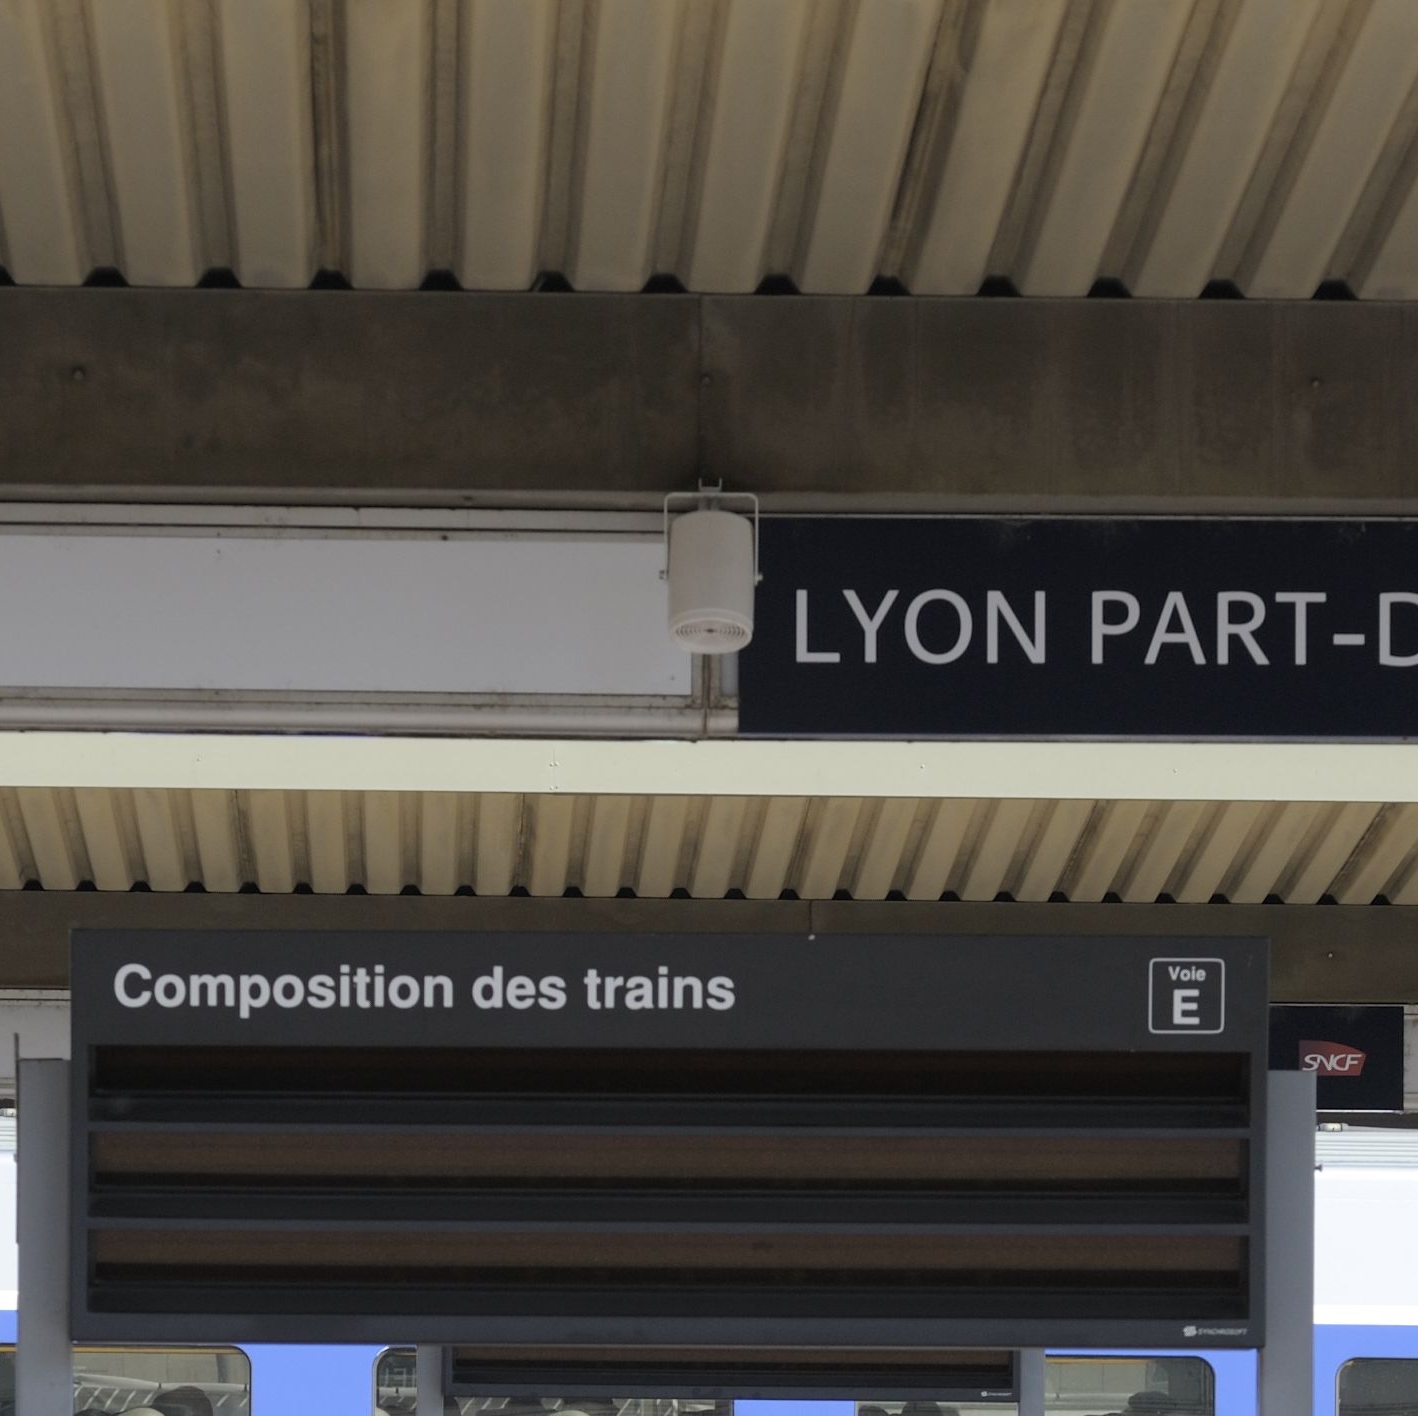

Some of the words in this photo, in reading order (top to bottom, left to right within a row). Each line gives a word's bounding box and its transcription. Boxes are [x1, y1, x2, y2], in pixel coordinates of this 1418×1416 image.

[795, 588, 1047, 665] LYON
[112, 963, 455, 1019] Composition
[471, 965, 568, 1010] des
[583, 965, 737, 1010] trains
[1167, 965, 1207, 982] Voie
[1172, 988, 1201, 1025] E
[1301, 1053, 1363, 1072] SNCF
